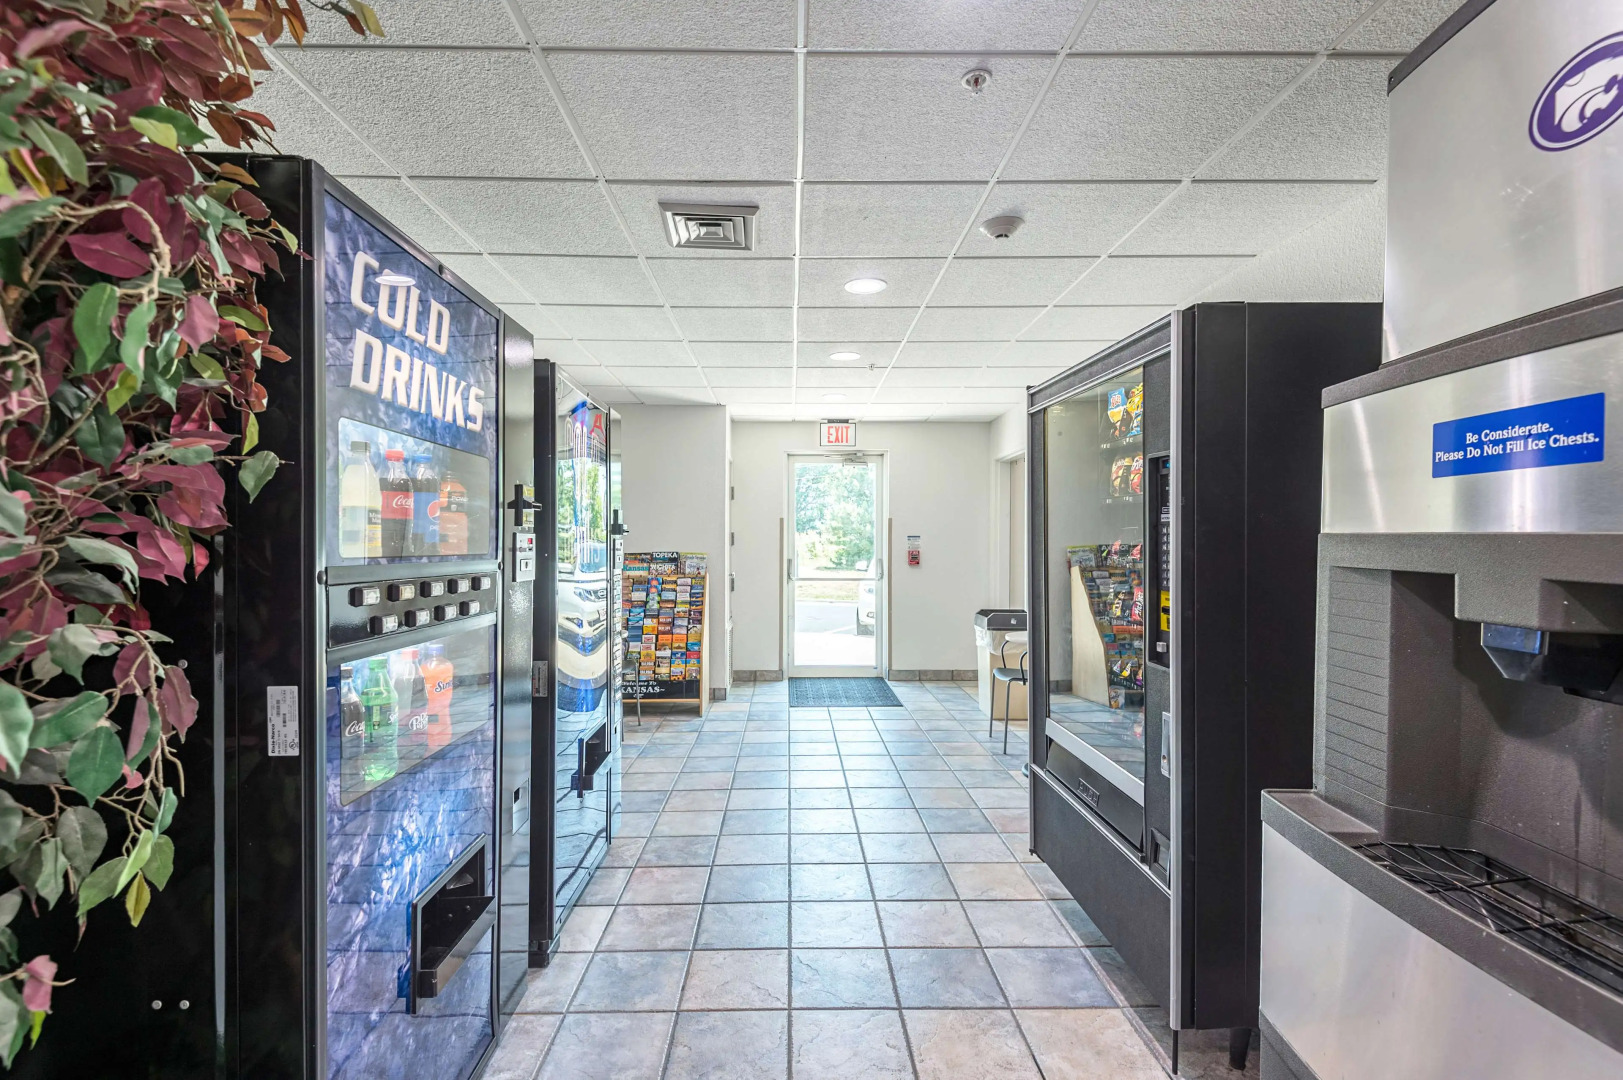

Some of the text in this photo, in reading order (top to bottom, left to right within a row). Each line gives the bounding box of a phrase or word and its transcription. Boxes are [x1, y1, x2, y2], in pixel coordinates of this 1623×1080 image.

[350, 251, 450, 355] COLD
[350, 328, 485, 432] DRINKS
[827, 426, 850, 443] EXIT
[1435, 431, 1599, 462] Please Do Not Fill Ice Chests.
[1466, 422, 1554, 444] Be Considerate.
